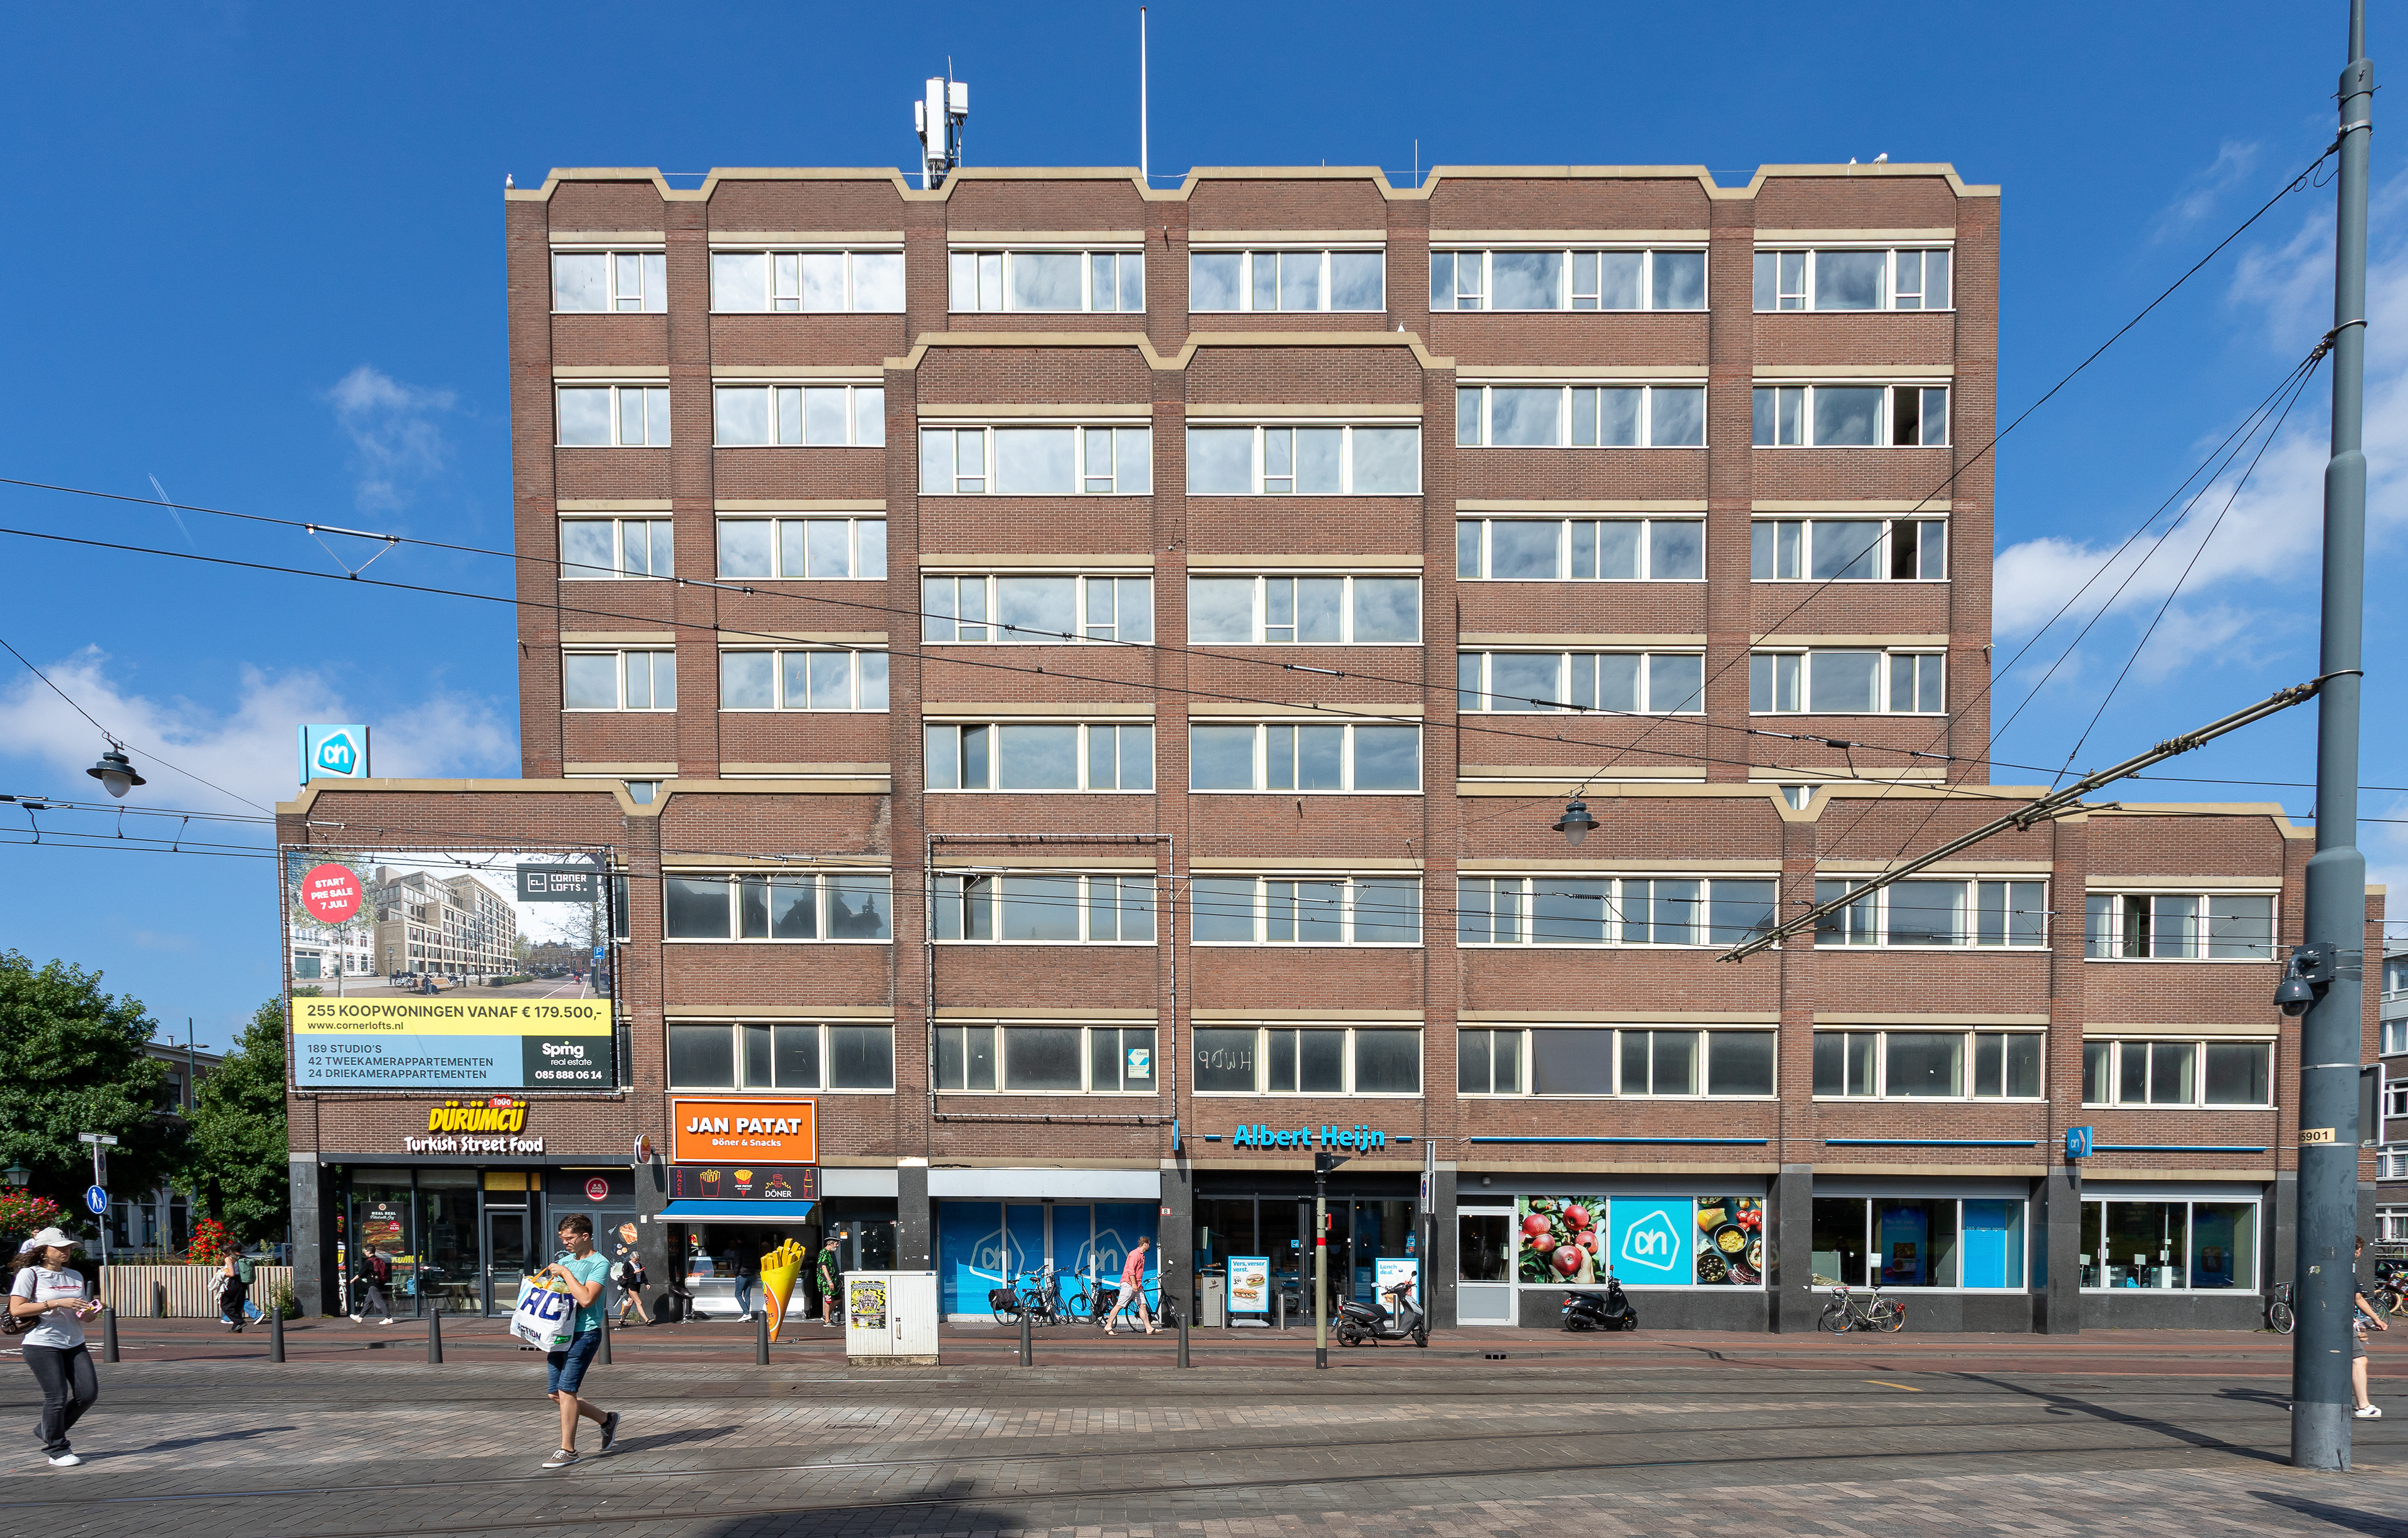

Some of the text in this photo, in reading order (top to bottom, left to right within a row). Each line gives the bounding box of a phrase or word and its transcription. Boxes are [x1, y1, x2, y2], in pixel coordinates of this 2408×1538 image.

[314, 878, 345, 888] START
[551, 874, 587, 883] CORNER
[310, 888, 353, 900] PRE SALE
[320, 899, 347, 910] 7 JULI
[307, 1004, 602, 1021] 255 KOOPWONINGEN VANAF € 179.500,-
[307, 1021, 404, 1031] www.cornerlofts.nl
[307, 1044, 327, 1054] 189
[541, 1040, 584, 1059] Spring
[308, 1056, 494, 1067] 42 TWEEKAMERAPPARTEMENTEN
[308, 1068, 487, 1079] 24 DRIEKAMERAPPARTEMENTEN
[535, 1070, 603, 1079] 085 888 06 14
[428, 1100, 527, 1132] DÜRÜMCÜ
[685, 1116, 802, 1134] JAN PATAT
[712, 1137, 782, 1147] Döner & Snacks
[1233, 1124, 1385, 1152] Albert Heijn
[403, 1136, 544, 1153] Turkish Street Food
[764, 1189, 793, 1198] DÖNER
[516, 1322, 542, 1342] ACTION
